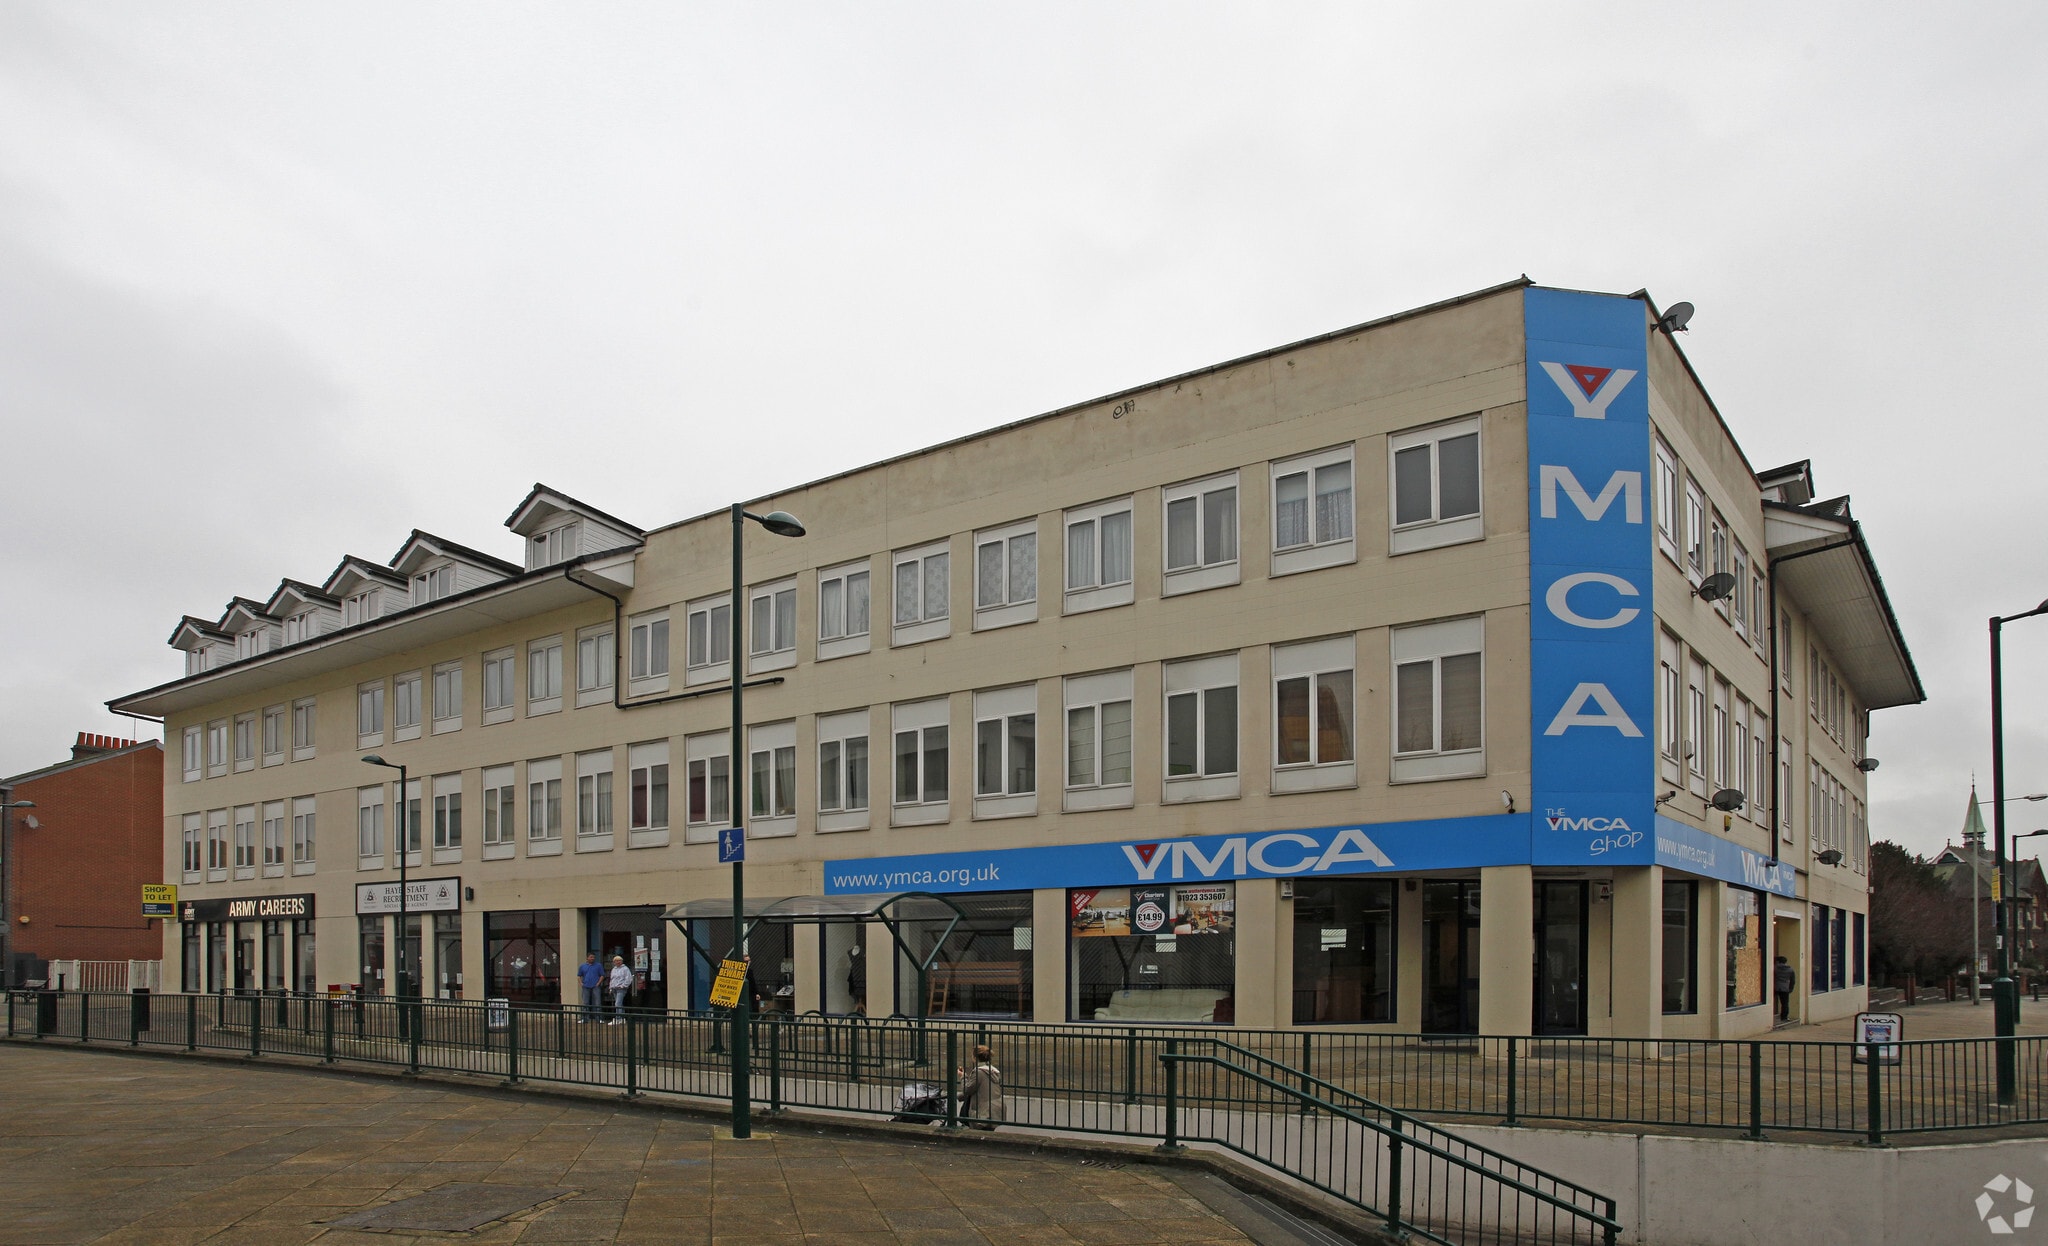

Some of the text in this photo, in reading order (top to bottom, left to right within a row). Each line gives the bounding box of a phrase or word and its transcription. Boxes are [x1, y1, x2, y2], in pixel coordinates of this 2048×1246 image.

[1545, 808, 1565, 816] THE
[1545, 817, 1631, 831] YMCA
[1120, 829, 1396, 880] YMCA
[1657, 836, 1715, 869] www.ymca.org.uk
[833, 863, 1000, 889] www.ymca.org.uk
[1741, 850, 1782, 892] YMCA
[407, 885, 426, 893] STAFF
[1177, 893, 1198, 901] 01923
[229, 898, 305, 917] ARMY CAREERS
[1137, 912, 1163, 921] £14.99
[722, 960, 747, 970] THIEVES
[719, 968, 745, 980] BEWARE
